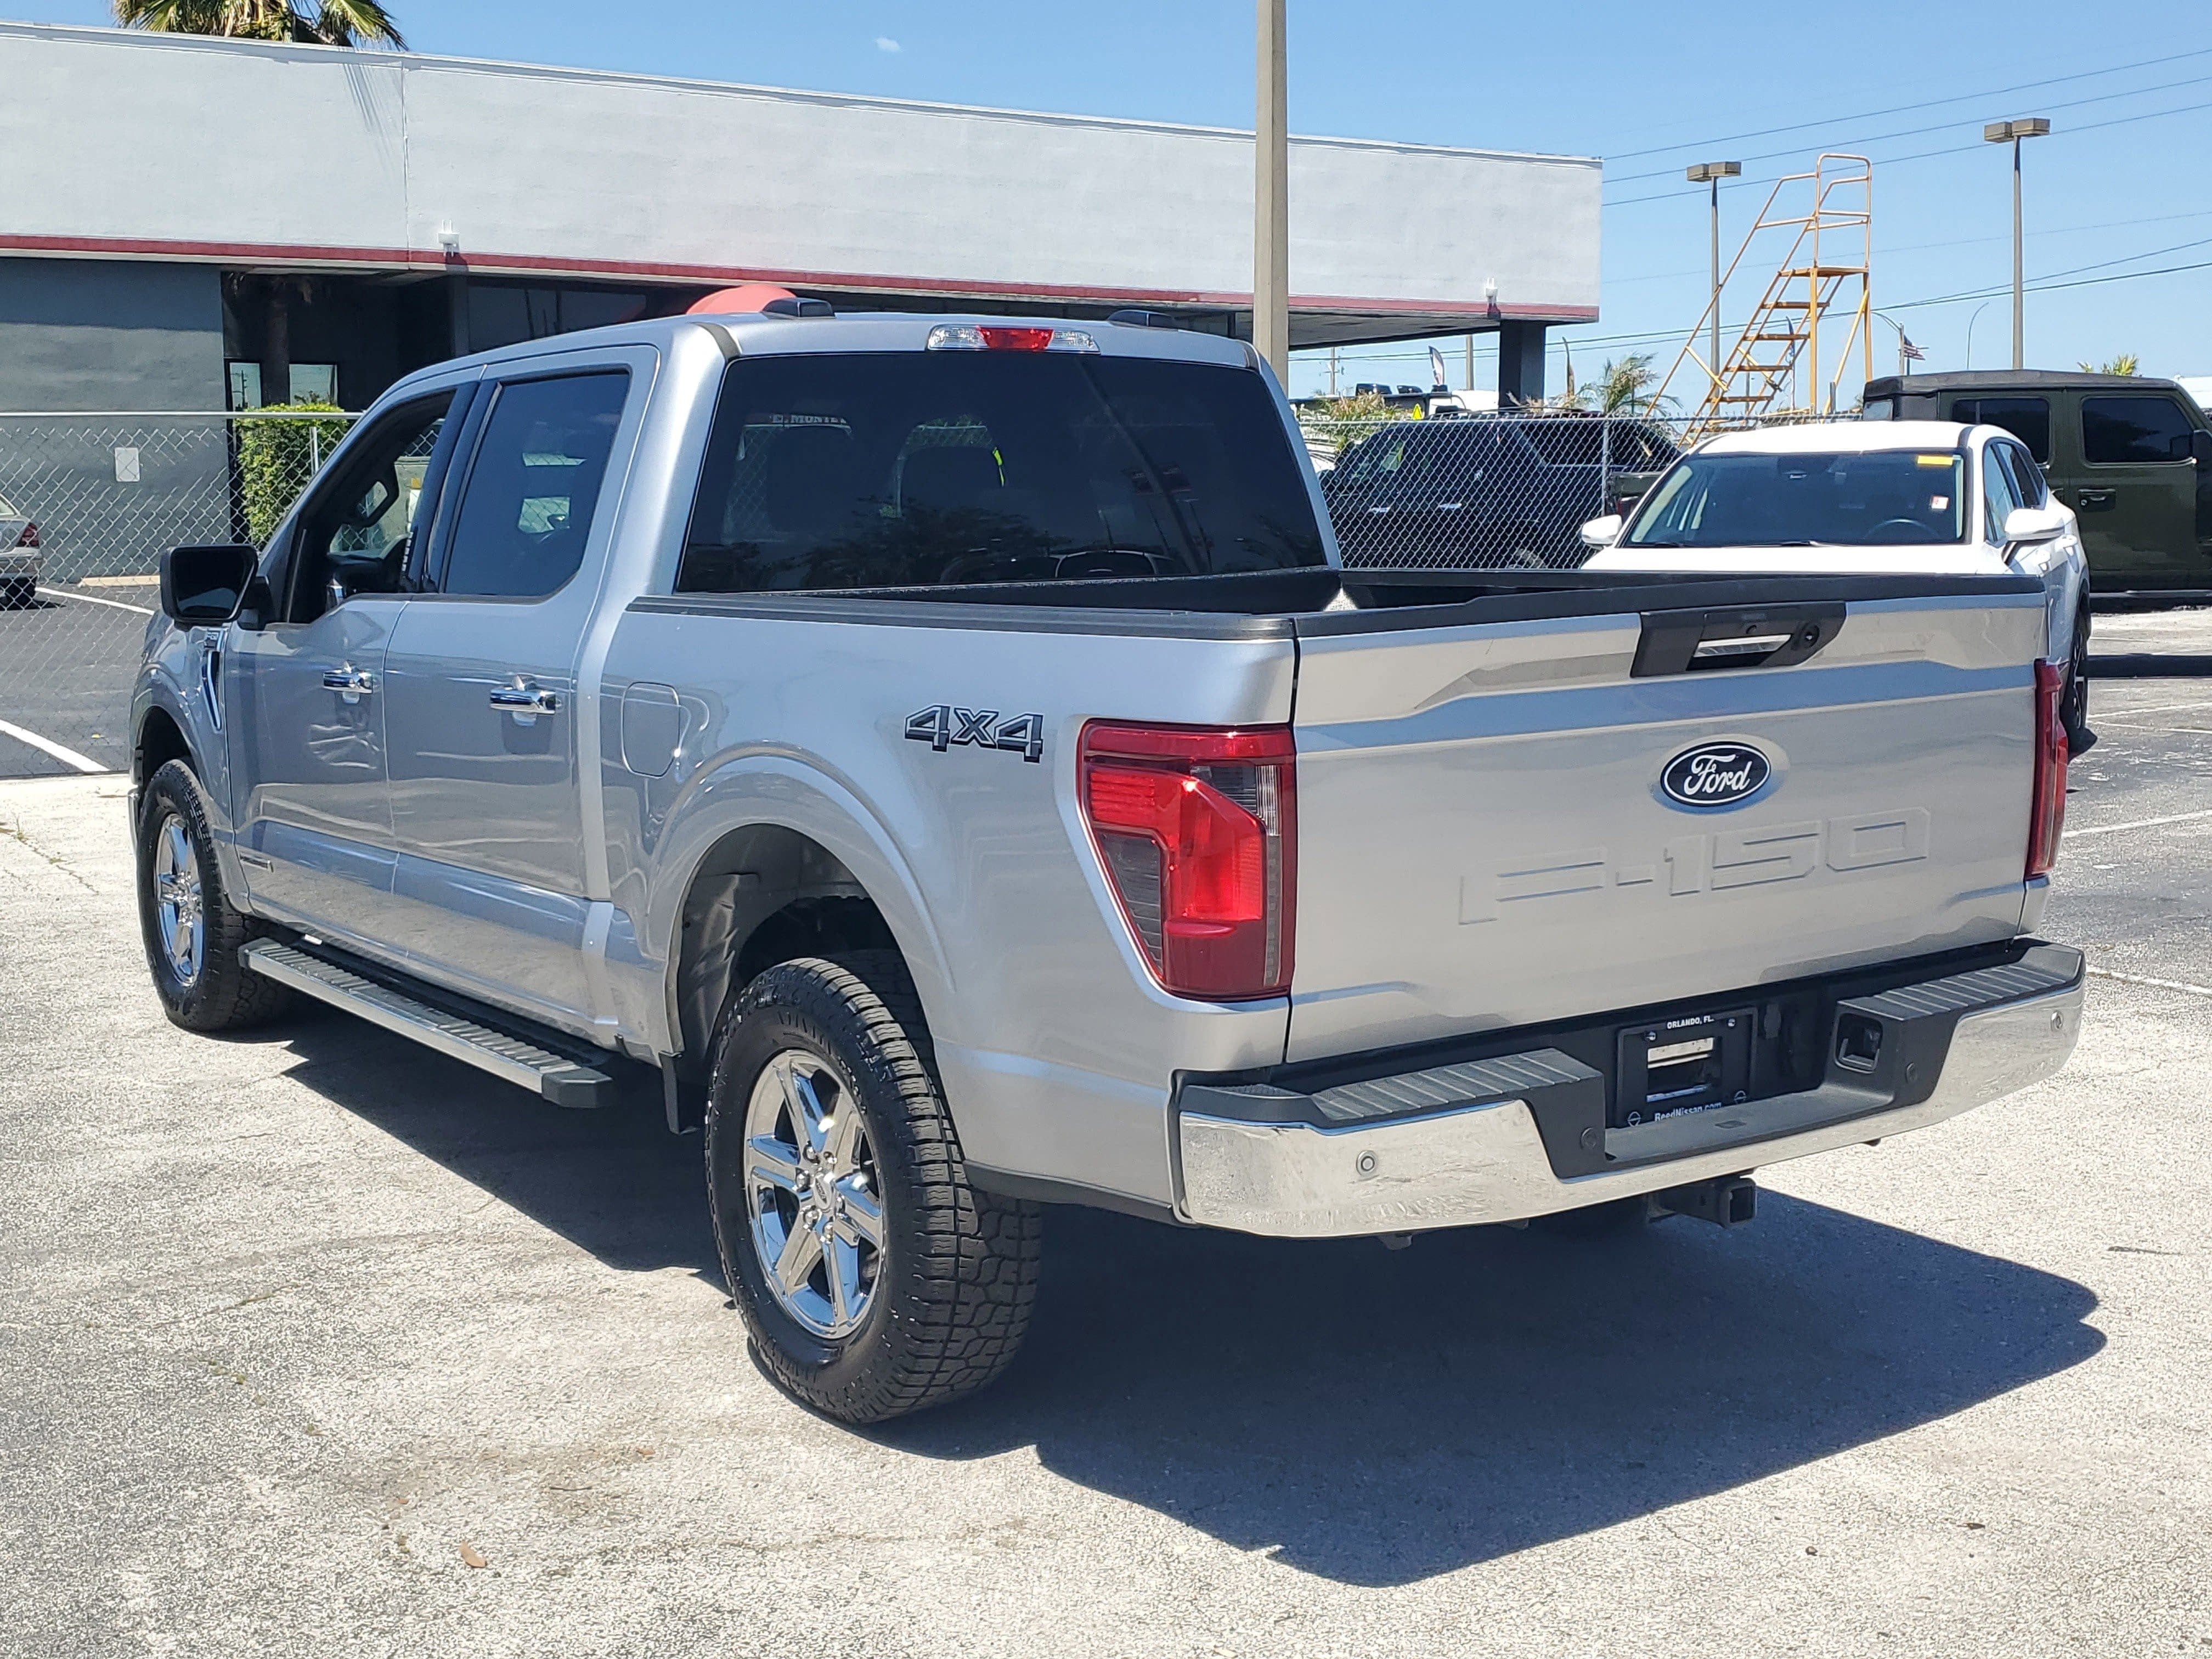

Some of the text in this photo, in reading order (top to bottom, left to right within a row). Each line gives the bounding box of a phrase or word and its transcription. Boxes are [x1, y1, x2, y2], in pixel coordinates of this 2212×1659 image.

[1684, 754, 1752, 795] Ford
[1459, 806, 1931, 925] F-150
[1667, 1017, 1702, 1029] ORLANDO,
